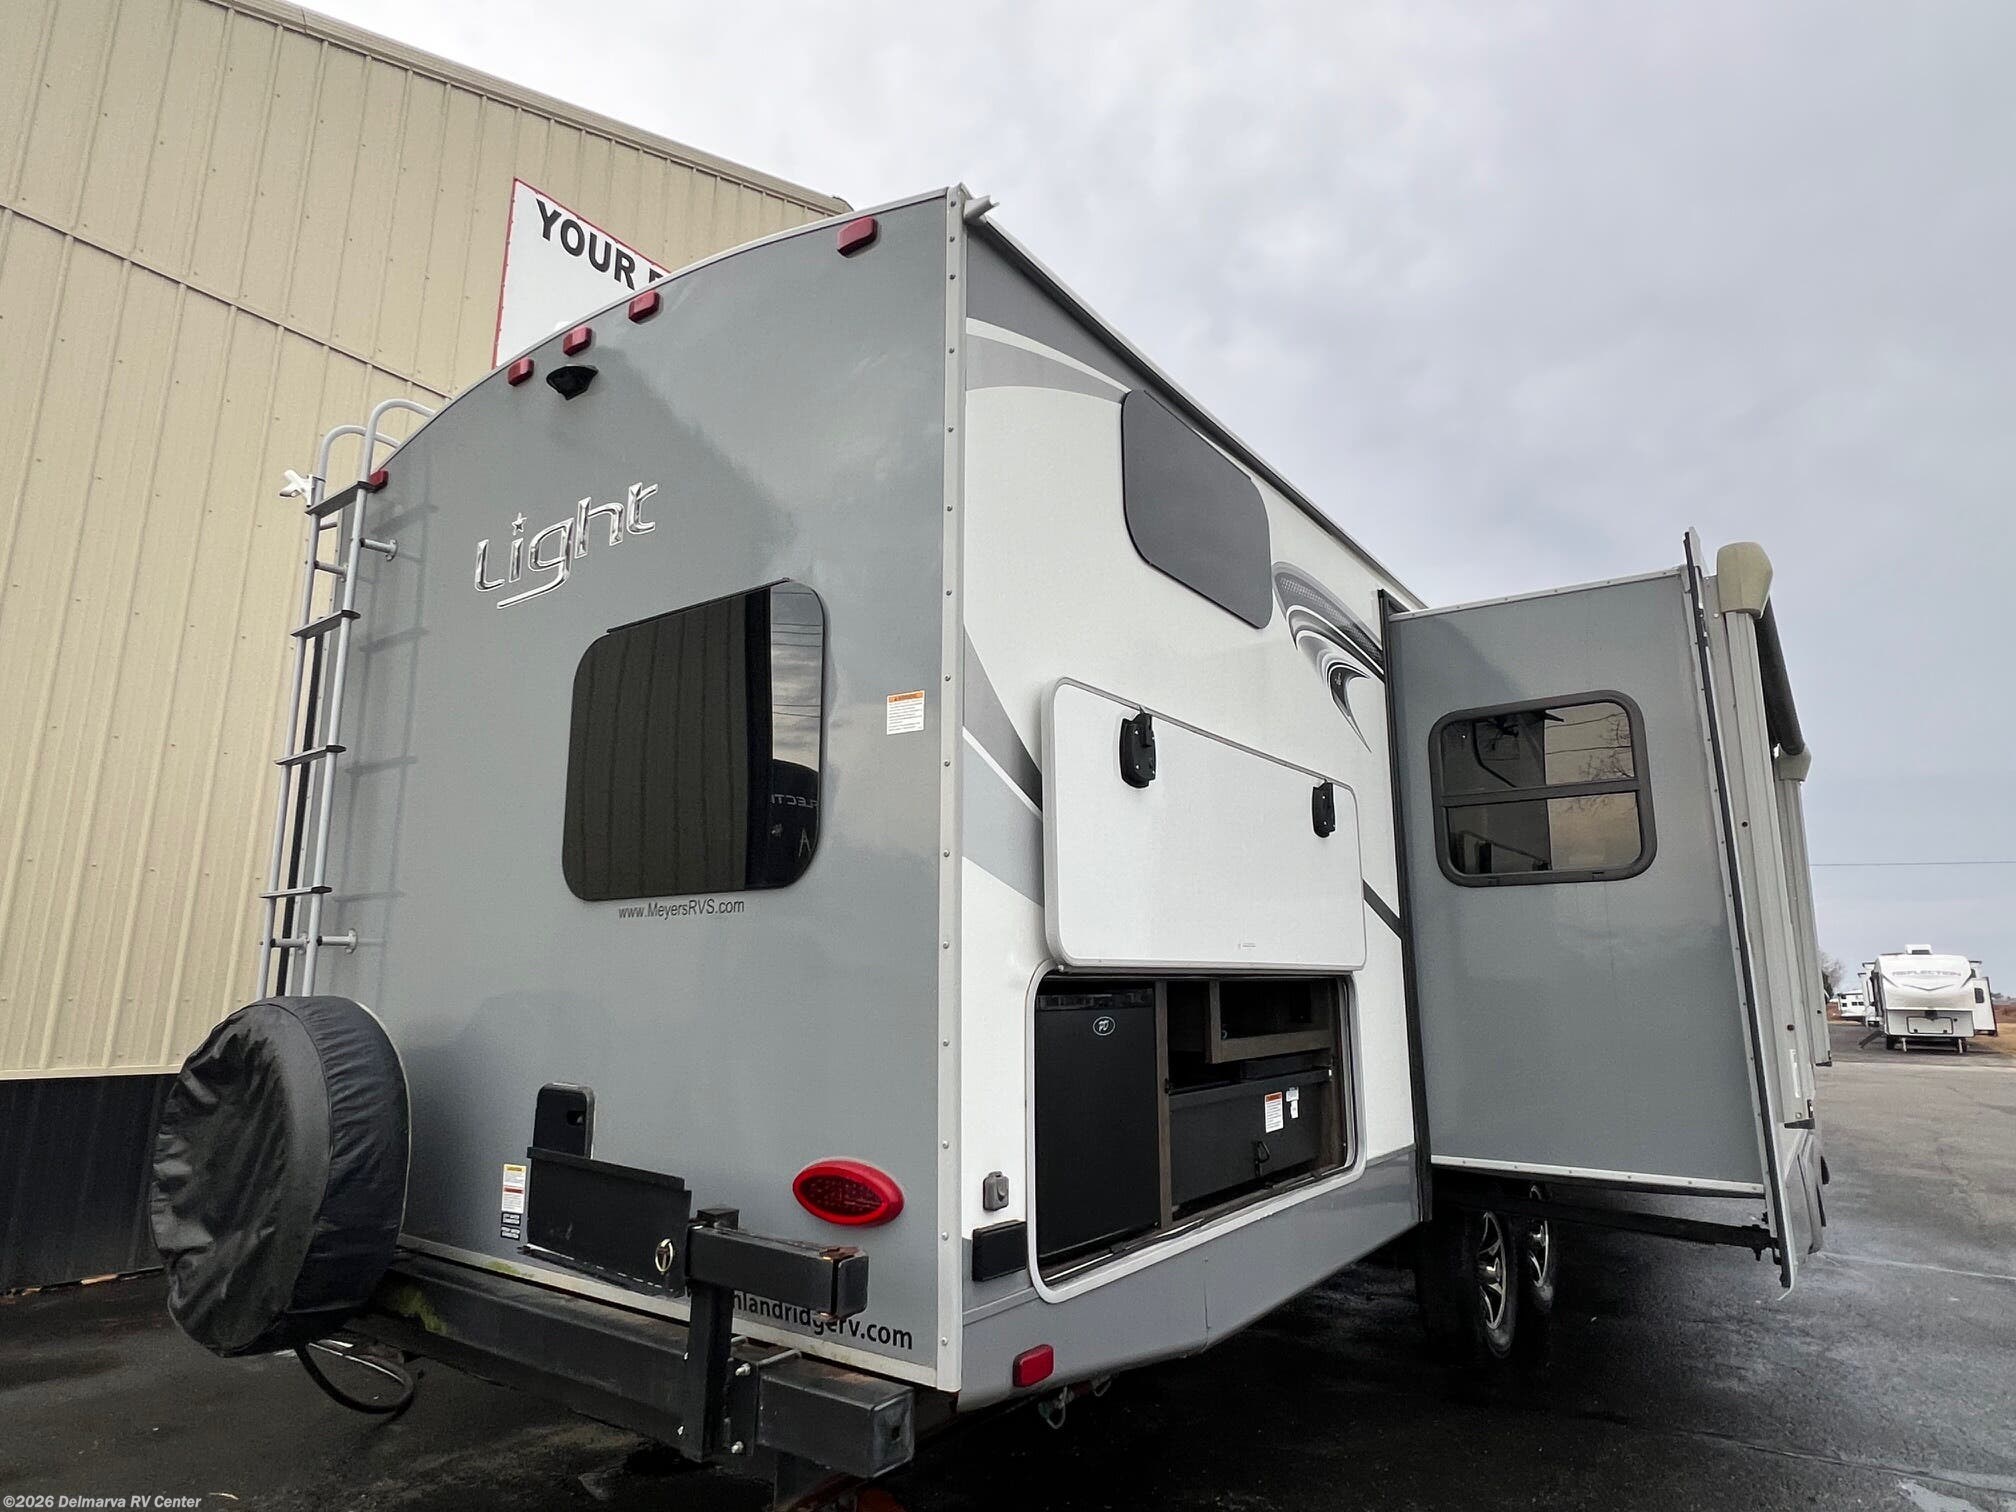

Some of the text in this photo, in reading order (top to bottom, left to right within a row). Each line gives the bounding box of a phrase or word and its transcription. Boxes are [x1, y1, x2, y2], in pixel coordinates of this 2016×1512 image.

[536, 198, 636, 291] YOUR
[473, 481, 659, 609] Light
[618, 898, 745, 921] www.MeyersRVS.com
